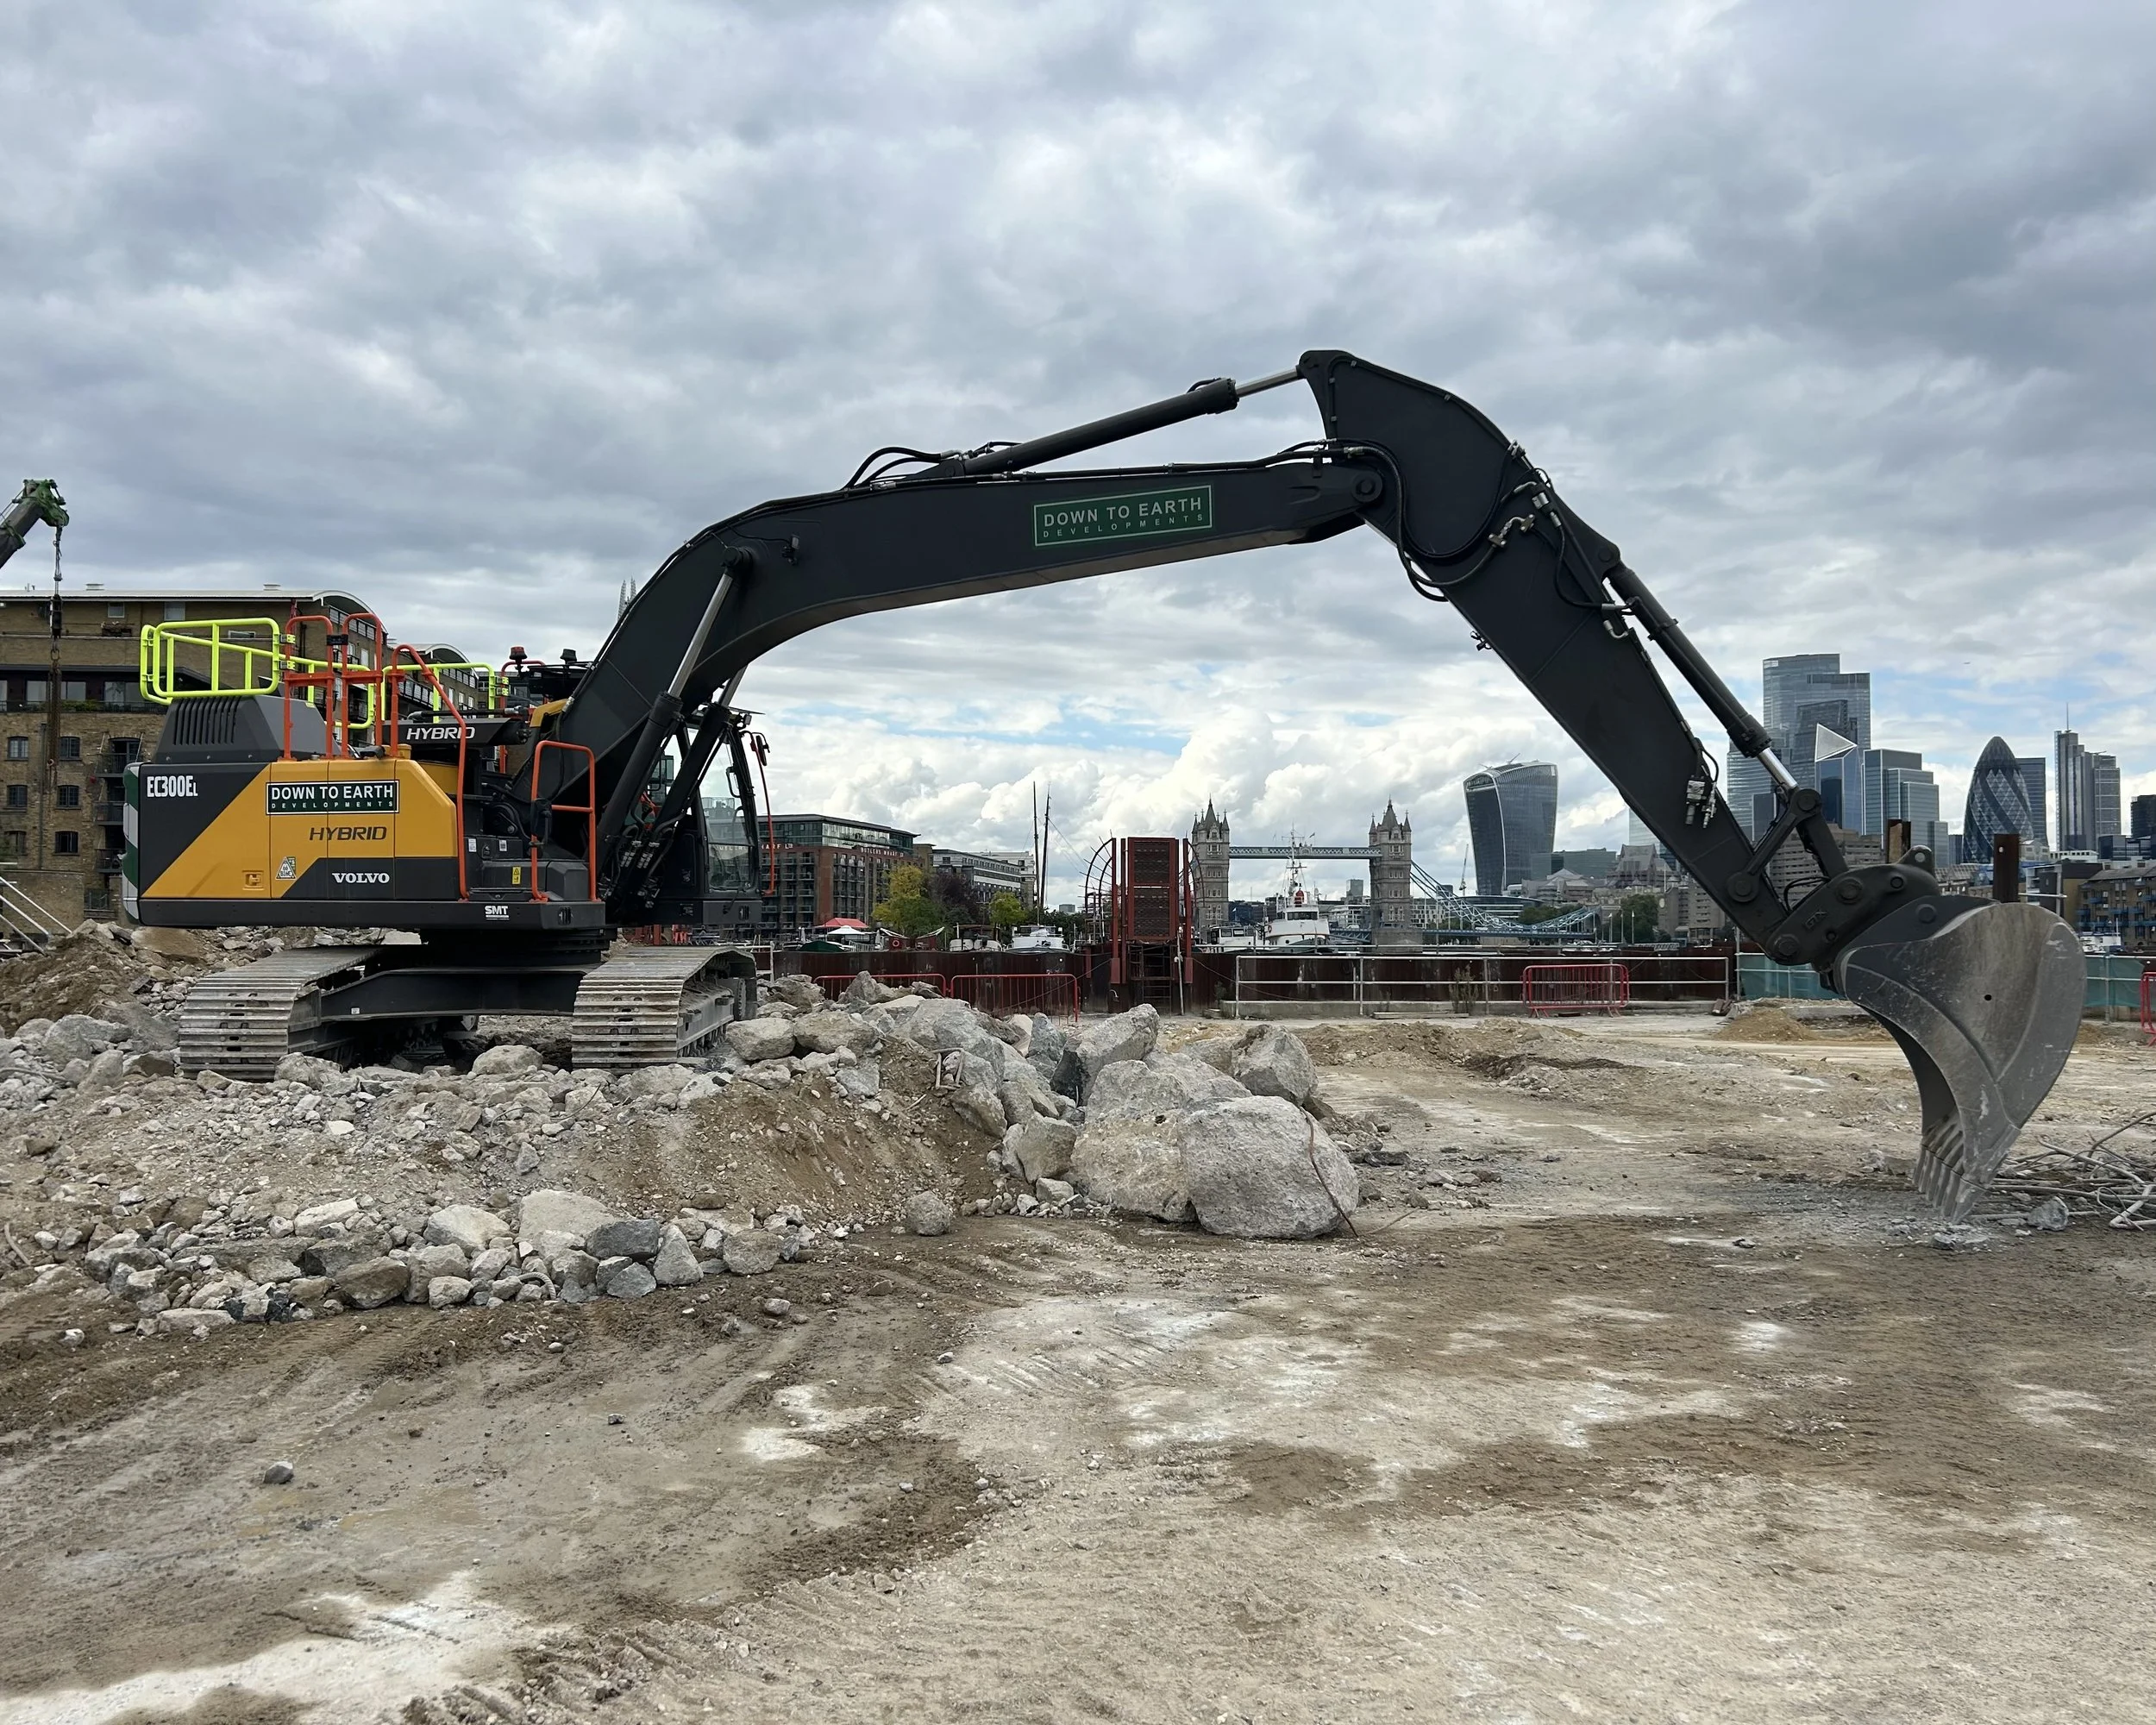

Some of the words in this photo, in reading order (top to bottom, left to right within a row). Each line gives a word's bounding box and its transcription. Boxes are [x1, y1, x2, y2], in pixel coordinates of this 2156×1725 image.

[1044, 509, 1098, 527] DOWN
[1106, 505, 1130, 520] TO
[1138, 497, 1202, 517] EARTH
[1043, 513, 1203, 538] DEVELOPMENTS
[406, 726, 476, 740] HYBRID
[271, 787, 315, 800] DOWN
[319, 786, 339, 799] TO
[343, 785, 393, 799] EARTH
[309, 826, 387, 841] HYBRID
[332, 872, 391, 884] VOLVO
[485, 905, 509, 915] SMT
